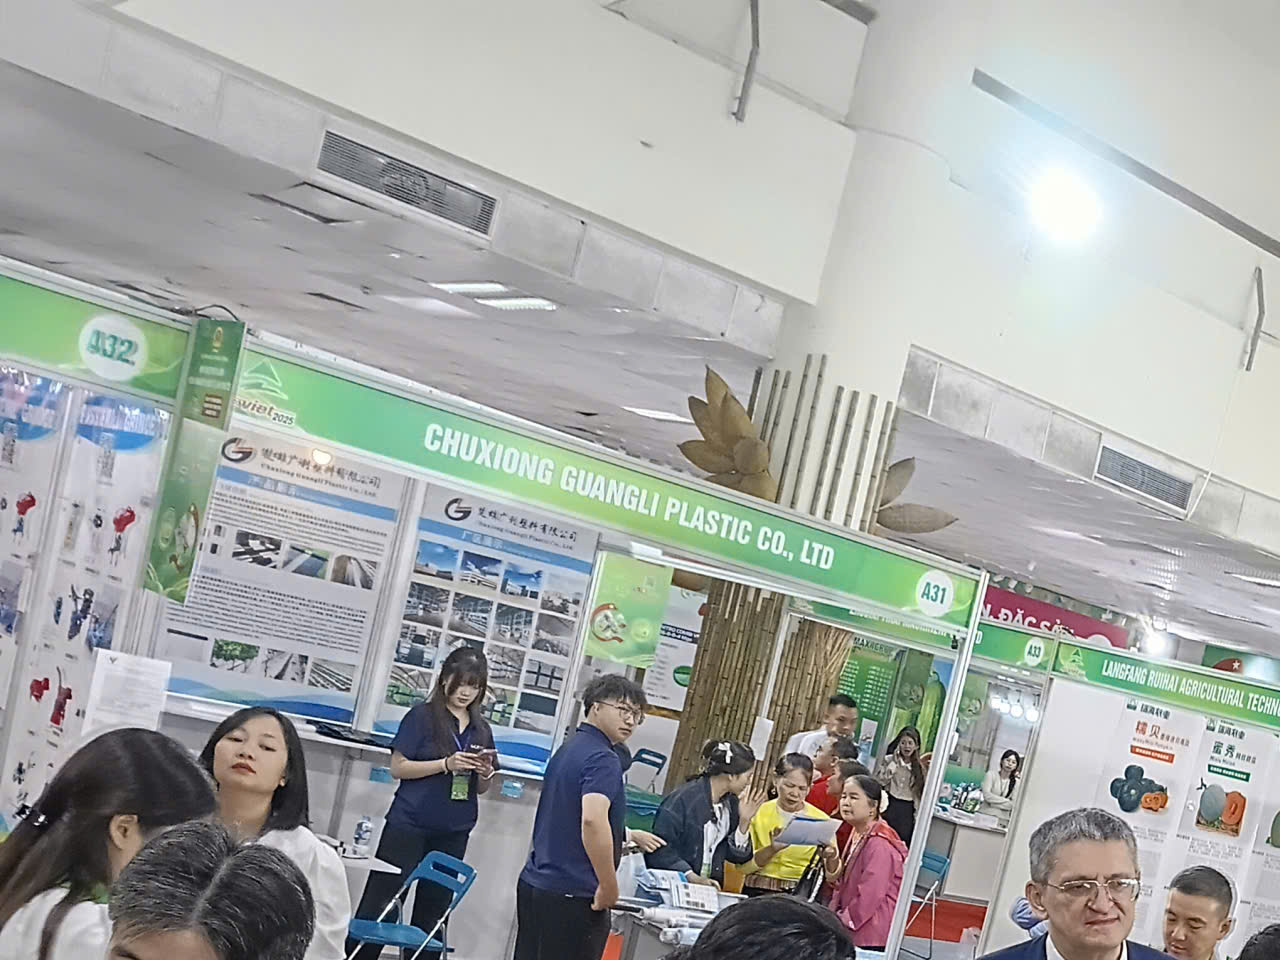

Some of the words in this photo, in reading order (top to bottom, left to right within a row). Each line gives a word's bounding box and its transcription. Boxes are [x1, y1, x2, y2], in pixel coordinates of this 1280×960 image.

[424, 423, 555, 485] CHUXIONG
[560, 466, 660, 517] GUANGLI
[664, 498, 753, 544] PLASTIC
[757, 527, 794, 561] CO.,
[800, 539, 835, 570] LTD
[921, 582, 947, 605] A31
[1027, 644, 1042, 658] A33
[1101, 660, 1148, 684] LANGFANG
[1147, 670, 1180, 692] RUIHAI
[1179, 677, 1244, 707] AGRICULTURAL
